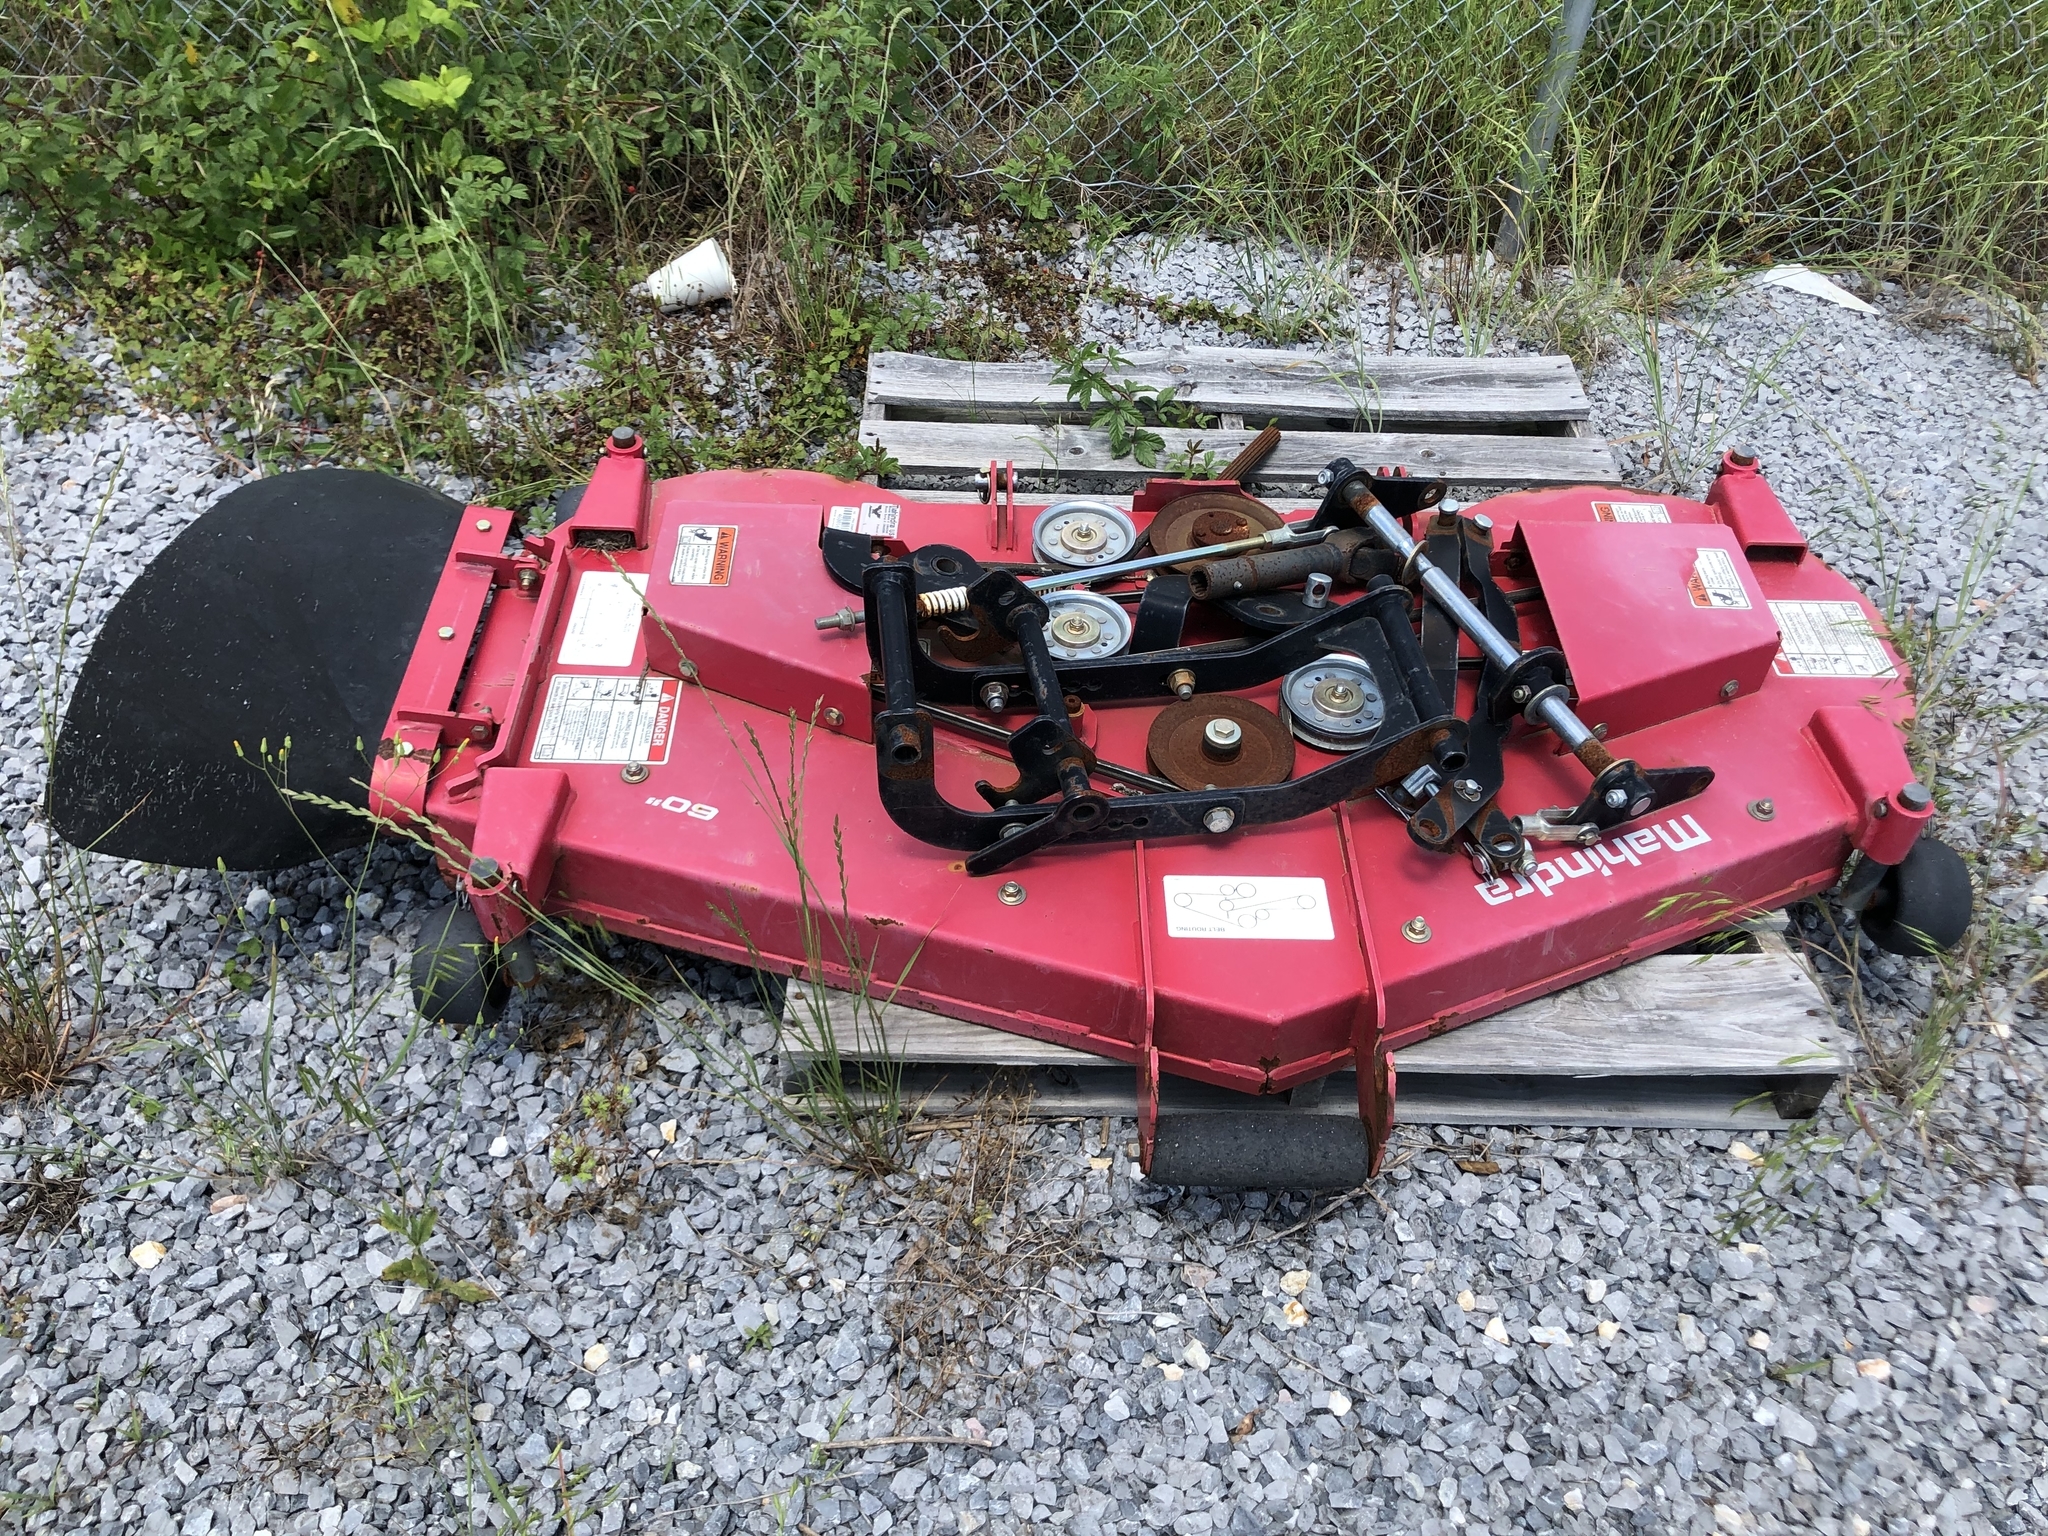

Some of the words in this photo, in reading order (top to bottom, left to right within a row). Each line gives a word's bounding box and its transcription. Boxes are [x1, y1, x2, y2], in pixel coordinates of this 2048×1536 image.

[713, 541, 730, 581] WARNING
[651, 706, 671, 747] DANGER
[645, 795, 719, 821] 60"
[1474, 814, 1712, 906] Mahindra
